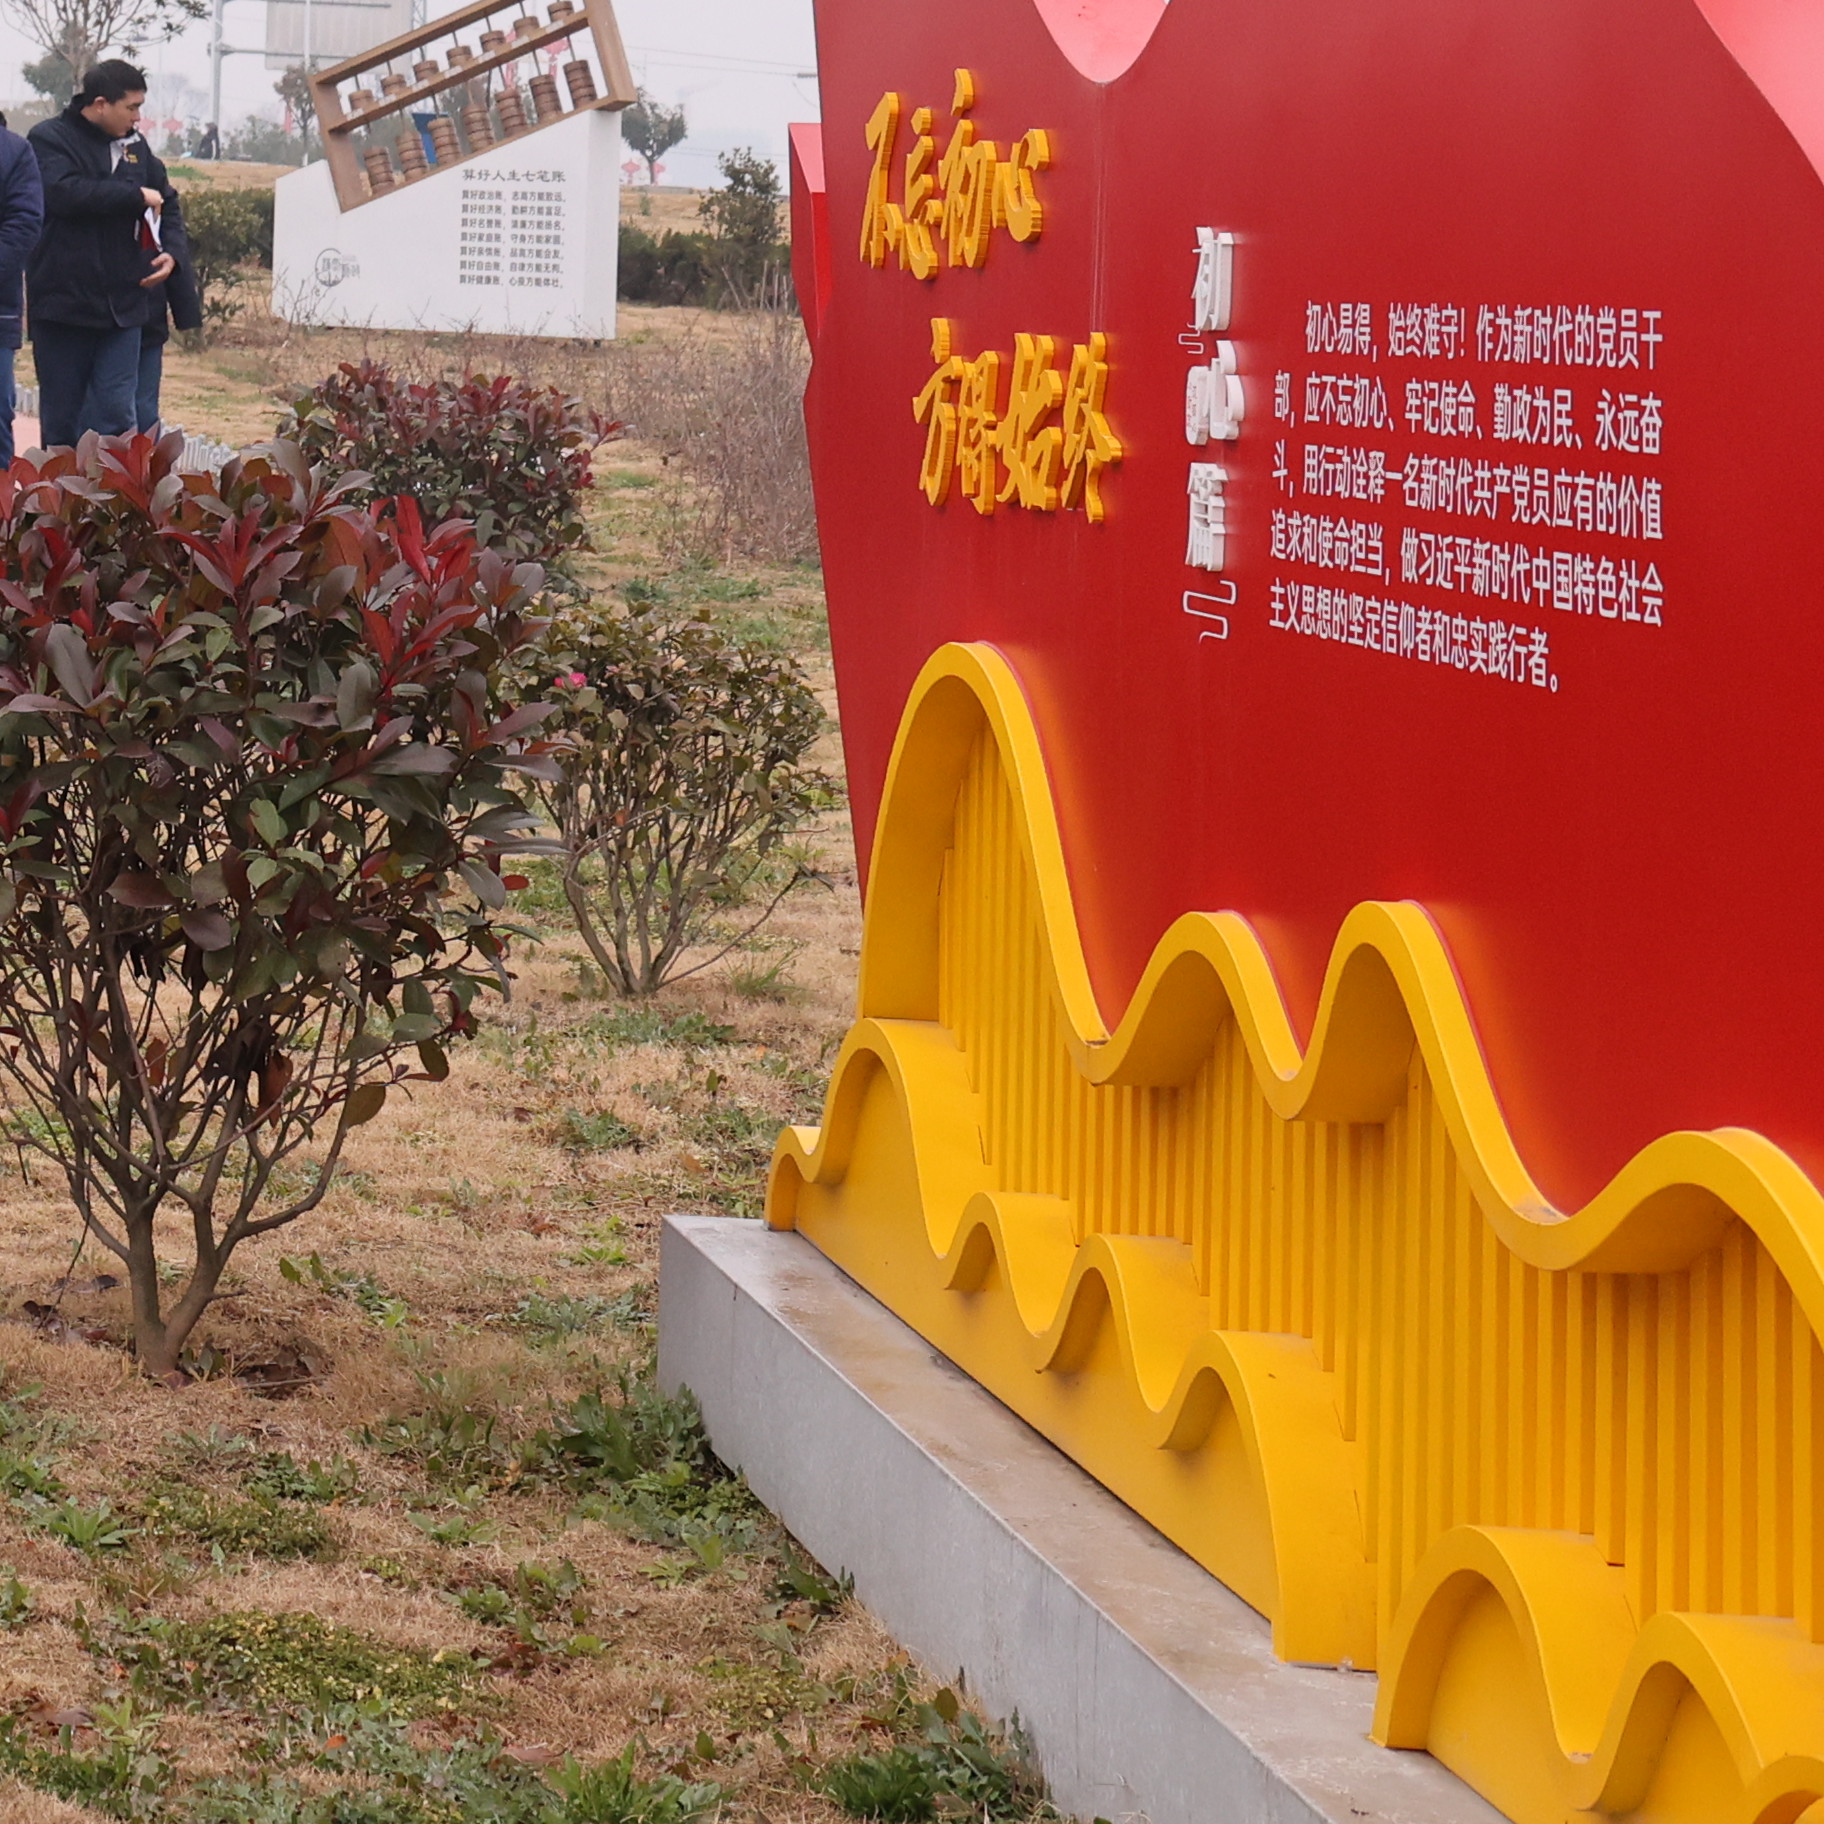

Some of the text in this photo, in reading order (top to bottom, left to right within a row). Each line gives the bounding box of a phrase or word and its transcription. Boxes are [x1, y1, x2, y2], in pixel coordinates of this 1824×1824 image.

[462, 169, 566, 183] 算好人生七笔账
[860, 68, 1050, 281] 不忘初心
[911, 317, 1122, 524] 方得始终
